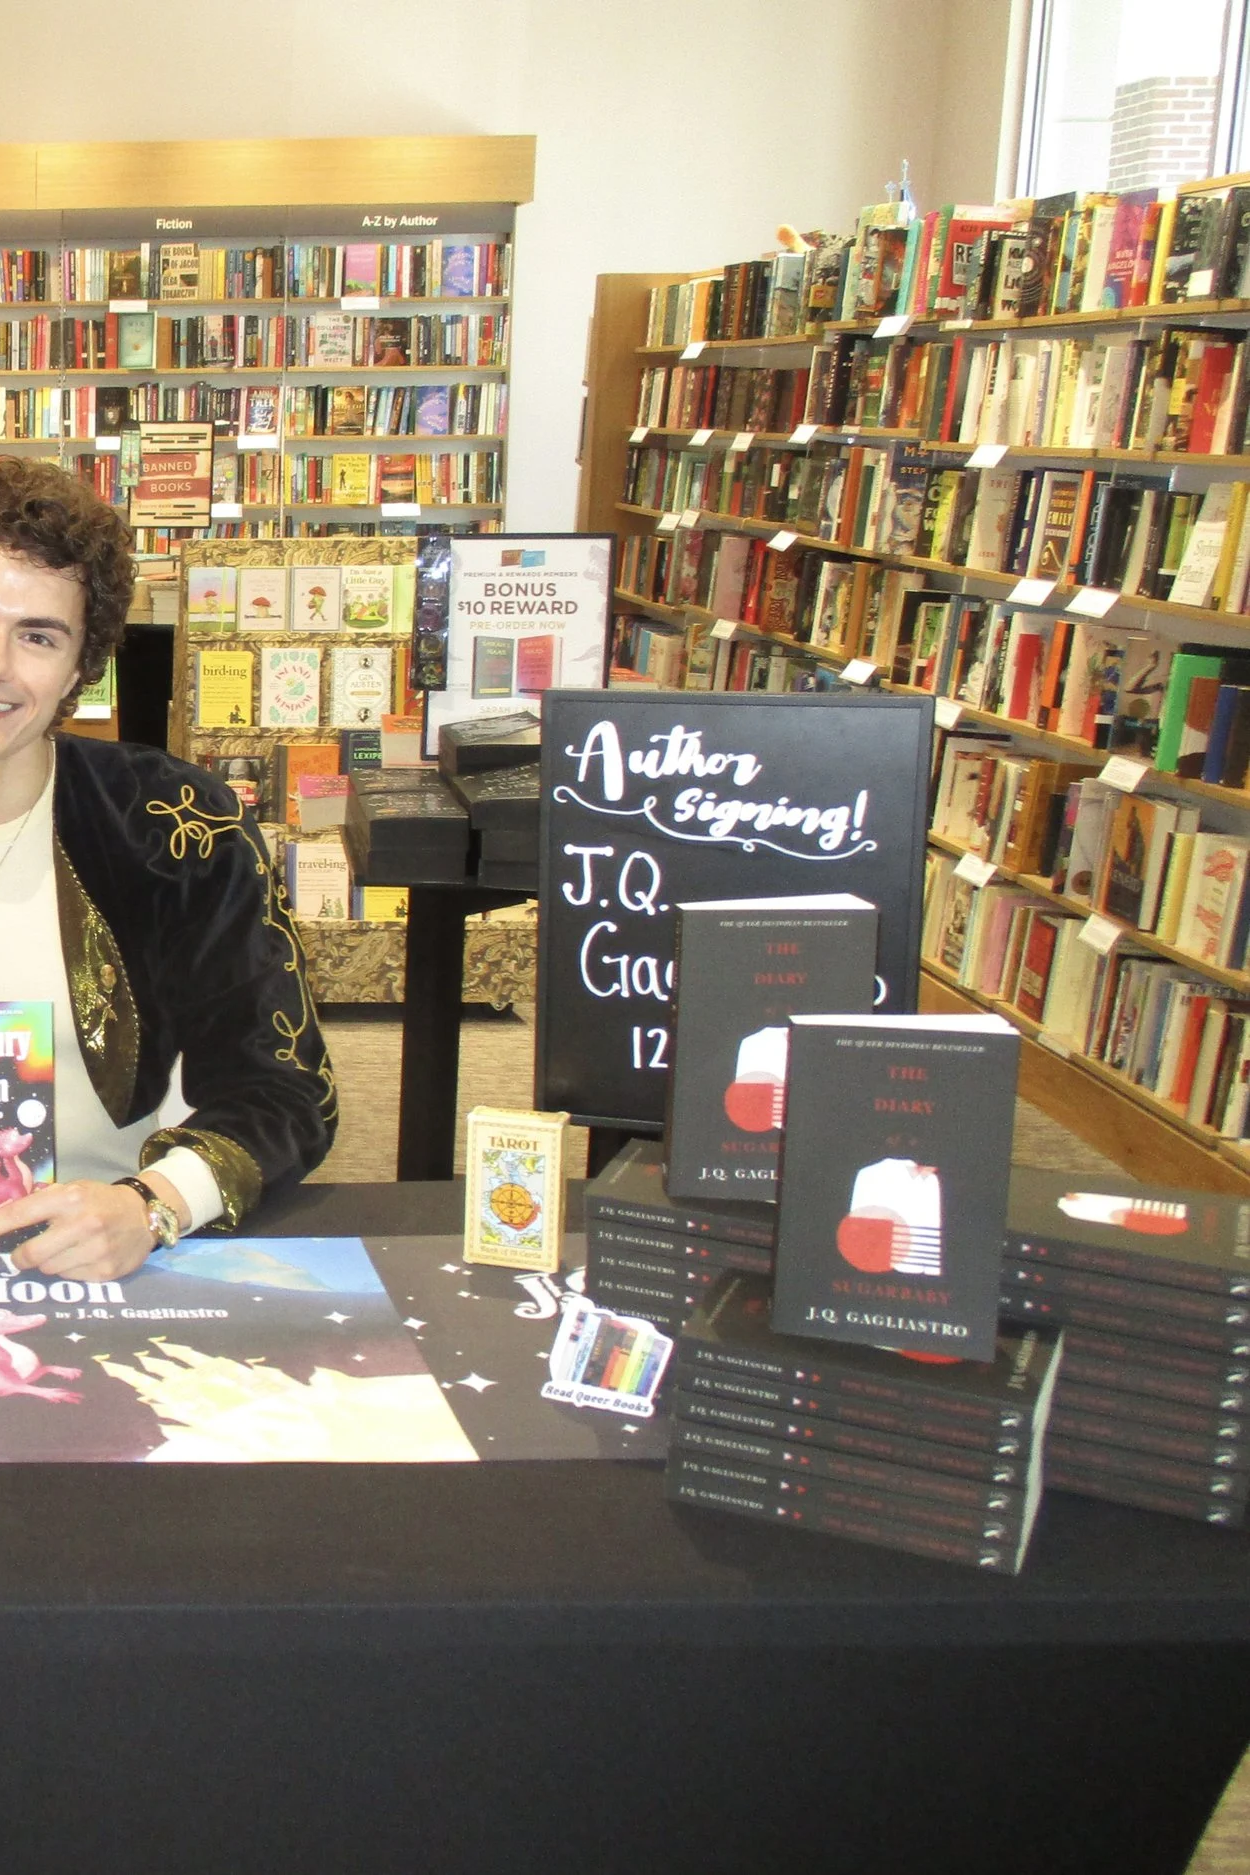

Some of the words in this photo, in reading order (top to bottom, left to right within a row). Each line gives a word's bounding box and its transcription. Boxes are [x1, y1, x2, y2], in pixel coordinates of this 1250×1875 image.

[156, 218, 193, 230] Fiction
[362, 215, 382, 227] A-Z
[384, 215, 397, 229] by
[399, 213, 439, 227] Author
[142, 461, 192, 473] BANNED
[150, 482, 192, 493] BOOKS
[484, 582, 557, 597] BONUS
[457, 601, 485, 615] $10
[491, 600, 578, 615] REWARD
[469, 621, 535, 630] PRE-ORDER
[539, 621, 566, 630] NOW
[564, 720, 763, 802] Author
[673, 787, 869, 851] Signing!
[561, 843, 671, 916] J.Q.
[753, 971, 808, 986] DIARY
[632, 1026, 669, 1069] 12
[887, 1065, 928, 1081] THE
[874, 1099, 935, 1115] DIARY
[488, 1136, 541, 1151] TAROT
[77, 1307, 115, 1320] J.Q.
[120, 1306, 229, 1321] Gagliastro
[806, 1306, 837, 1324] J.Q.
[845, 1311, 969, 1339] GAGLIASTRO
[545, 1385, 572, 1399] Read
[575, 1390, 611, 1409] Queer
[612, 1396, 650, 1414] Books
